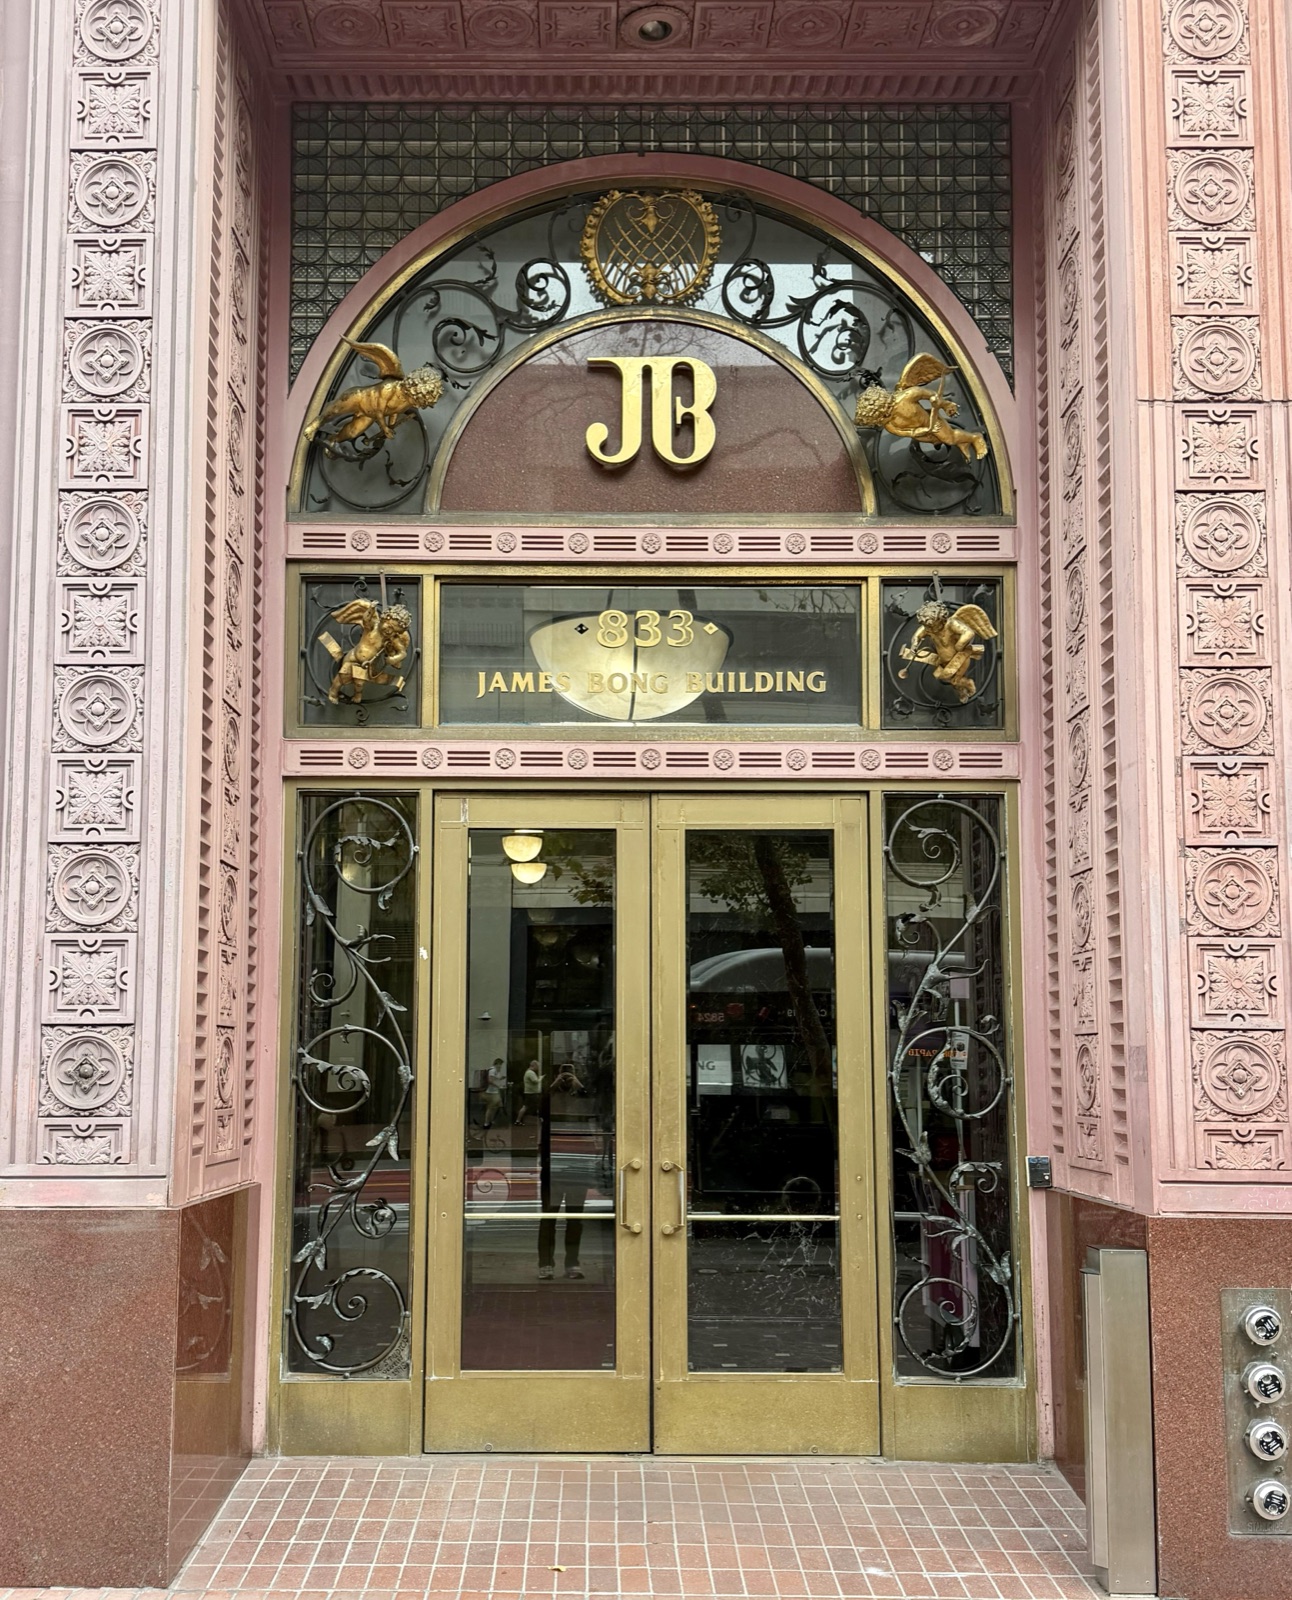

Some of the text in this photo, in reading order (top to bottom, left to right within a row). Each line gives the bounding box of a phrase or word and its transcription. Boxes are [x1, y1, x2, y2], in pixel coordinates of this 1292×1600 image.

[585, 356, 718, 465] JB
[595, 609, 695, 648] 833
[476, 670, 827, 698] JAMES BONG BUILDING
